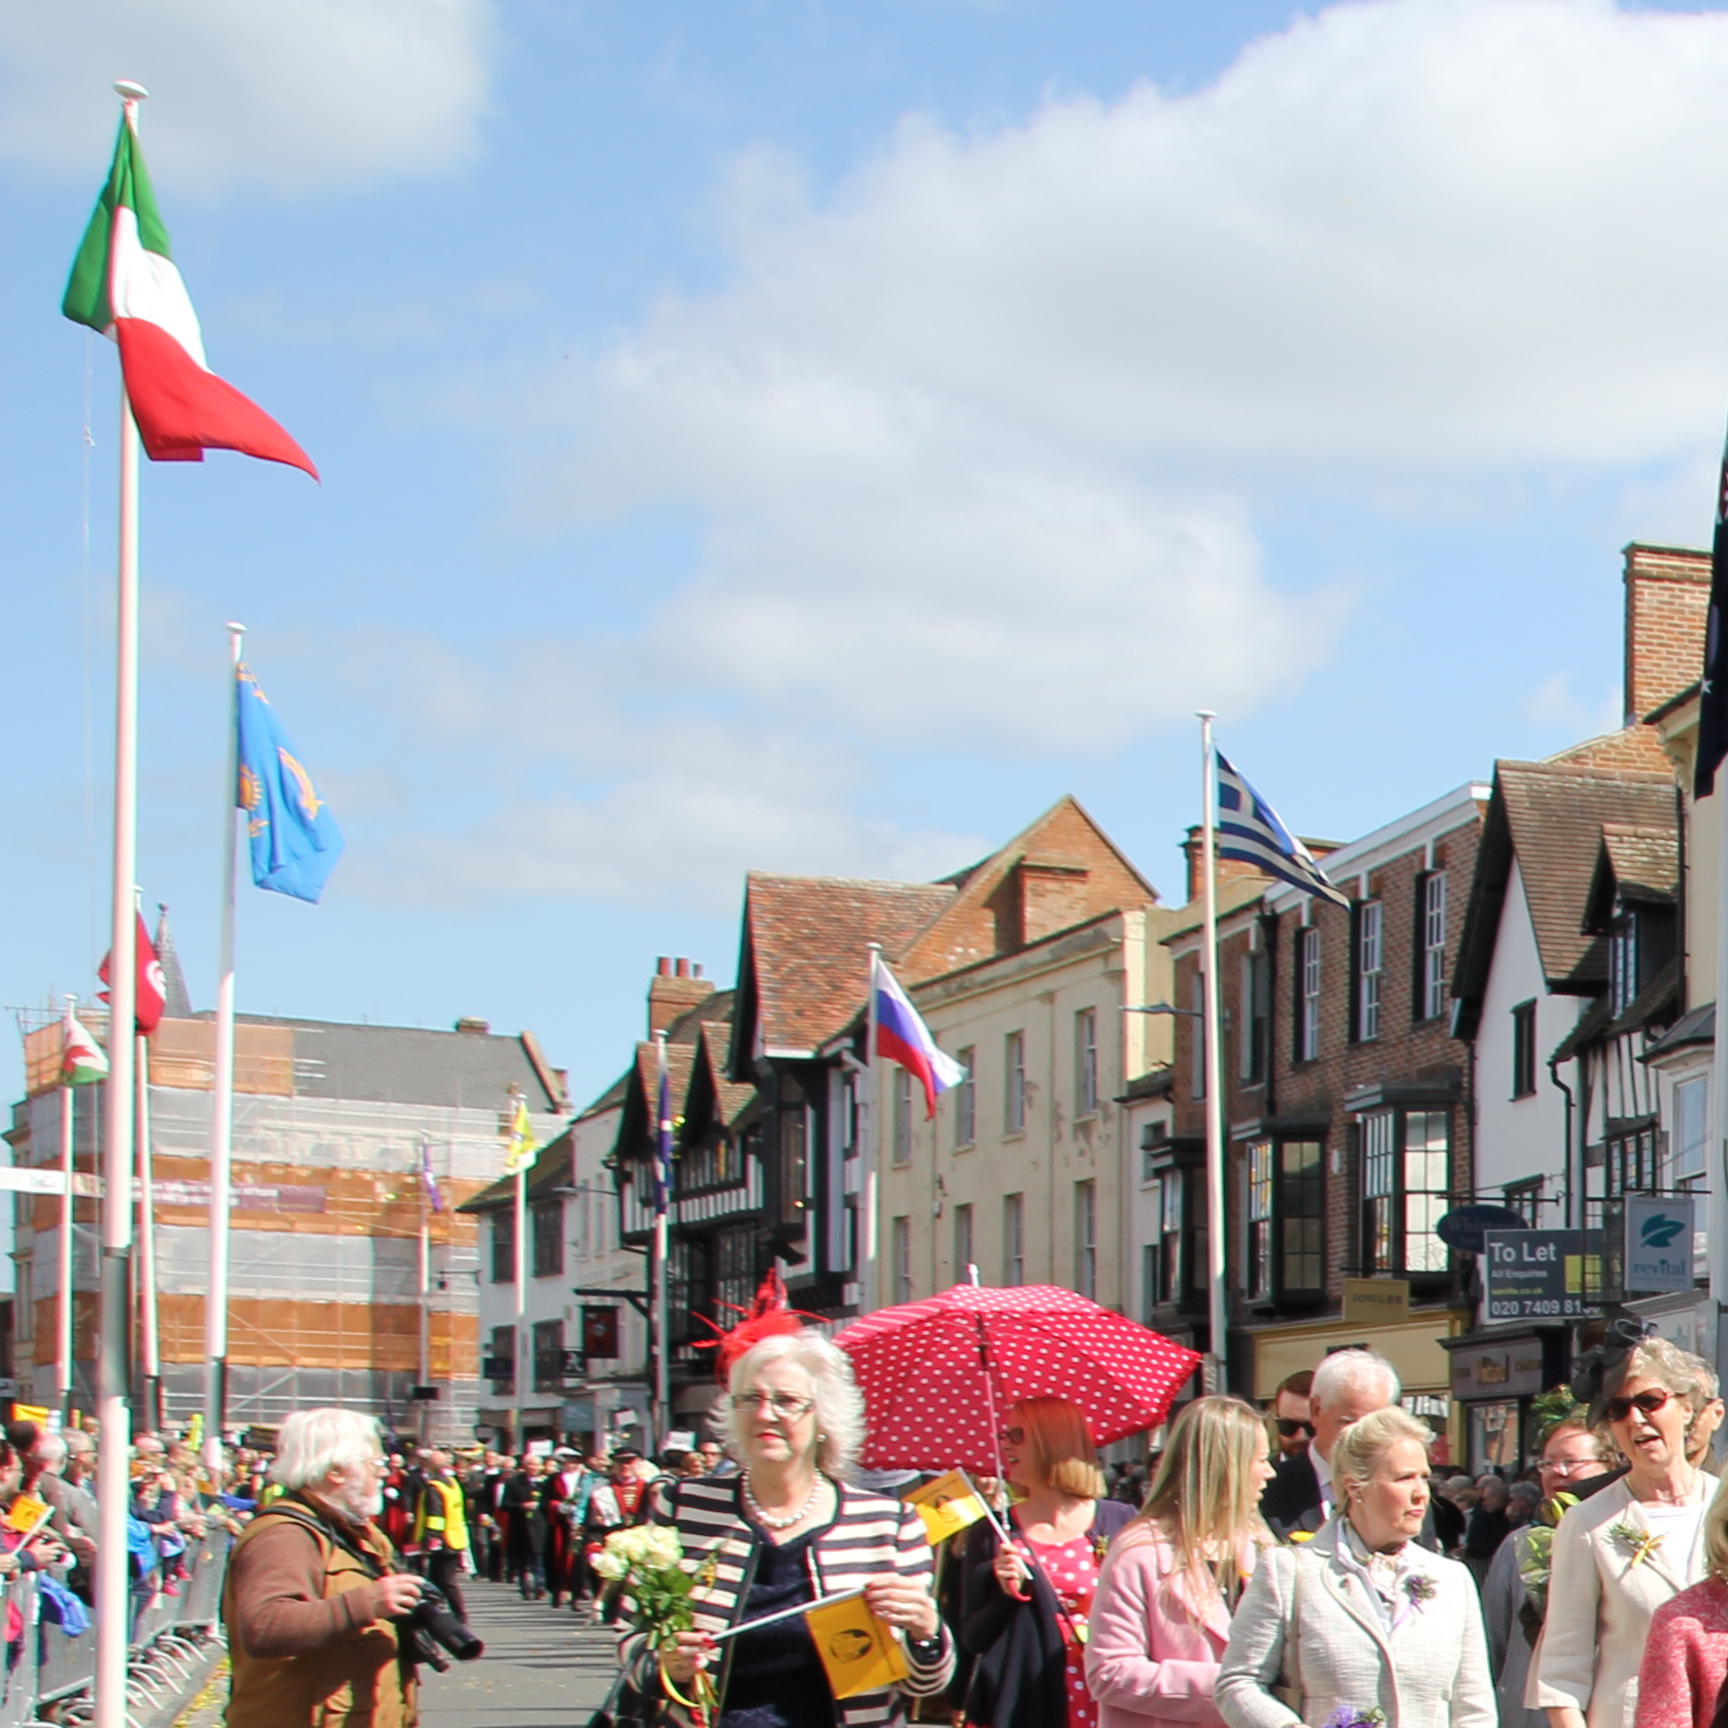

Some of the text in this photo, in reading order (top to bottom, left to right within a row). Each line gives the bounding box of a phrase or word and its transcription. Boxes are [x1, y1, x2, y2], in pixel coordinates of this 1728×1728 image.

[1489, 1241, 1557, 1264] To Let
[1632, 1258, 1686, 1276] revital
[1491, 1300, 1520, 1316] 020
[1522, 1299, 1560, 1315] 7409
